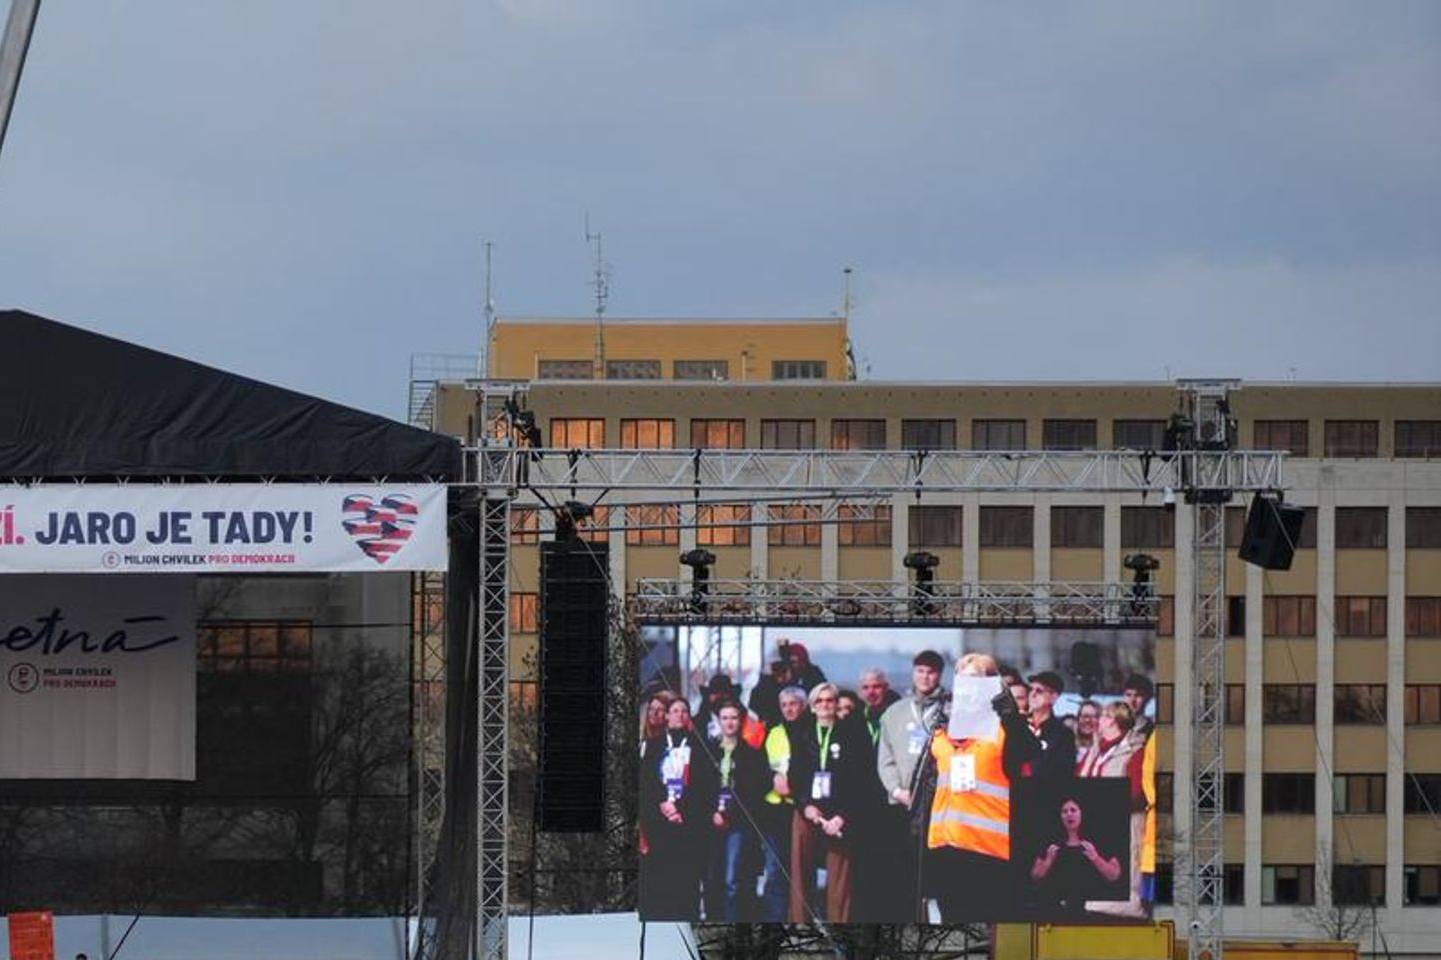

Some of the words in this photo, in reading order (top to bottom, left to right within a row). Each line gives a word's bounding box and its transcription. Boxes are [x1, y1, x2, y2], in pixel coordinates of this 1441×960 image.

[35, 511, 136, 545] JARO
[146, 511, 192, 545] JE
[202, 511, 313, 544] TADY!
[124, 555, 159, 565] MILION
[162, 554, 207, 565] CHVILEK
[209, 554, 230, 564] PRO
